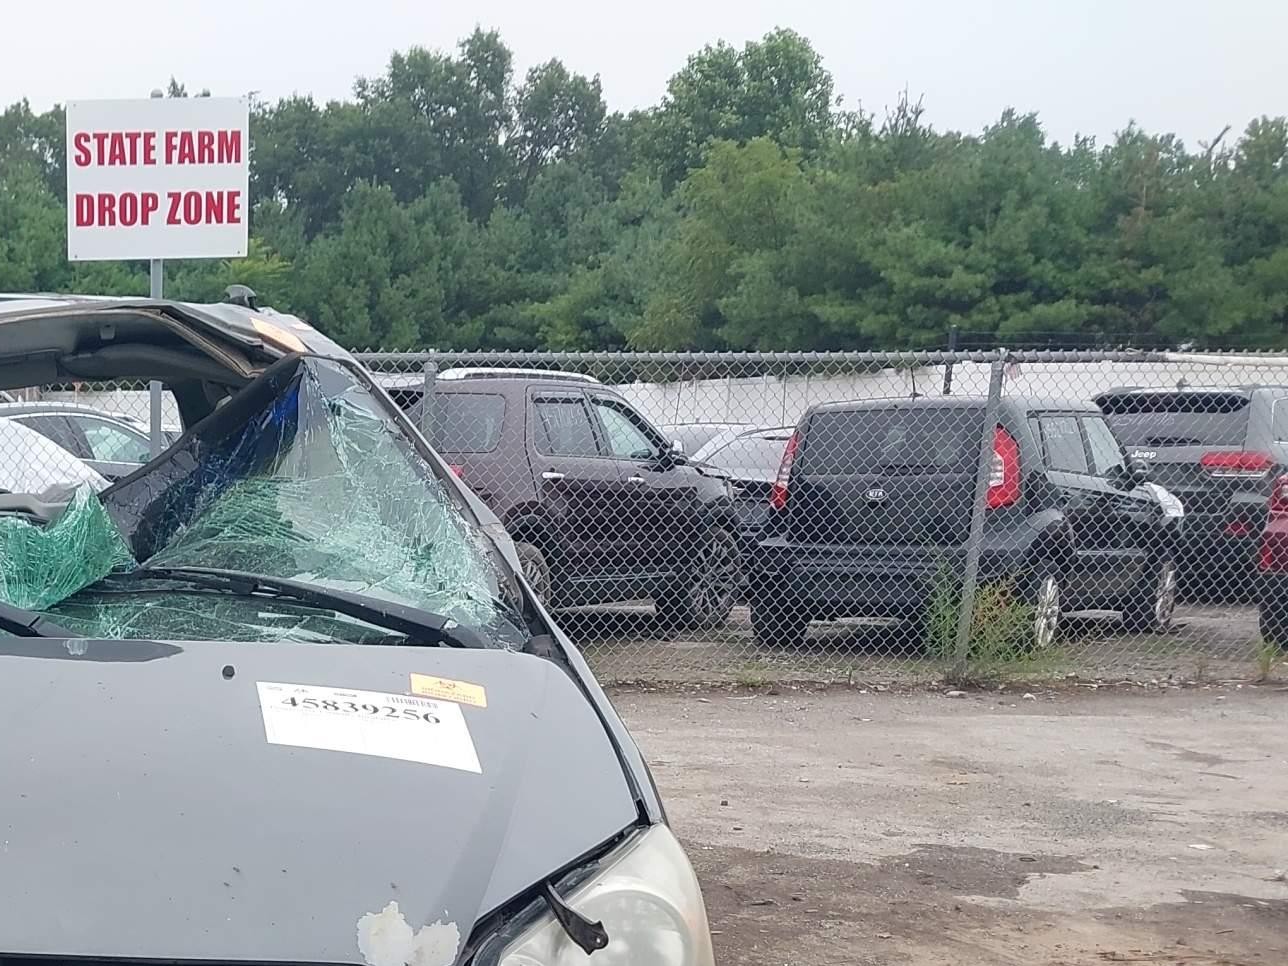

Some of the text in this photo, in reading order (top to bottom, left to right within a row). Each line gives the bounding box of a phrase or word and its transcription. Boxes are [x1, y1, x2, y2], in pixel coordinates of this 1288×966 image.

[74, 130, 241, 167] STATE FARM
[76, 190, 241, 227] DROP ZONE
[1130, 450, 1157, 459] Jeep
[281, 696, 441, 724] 45839256
